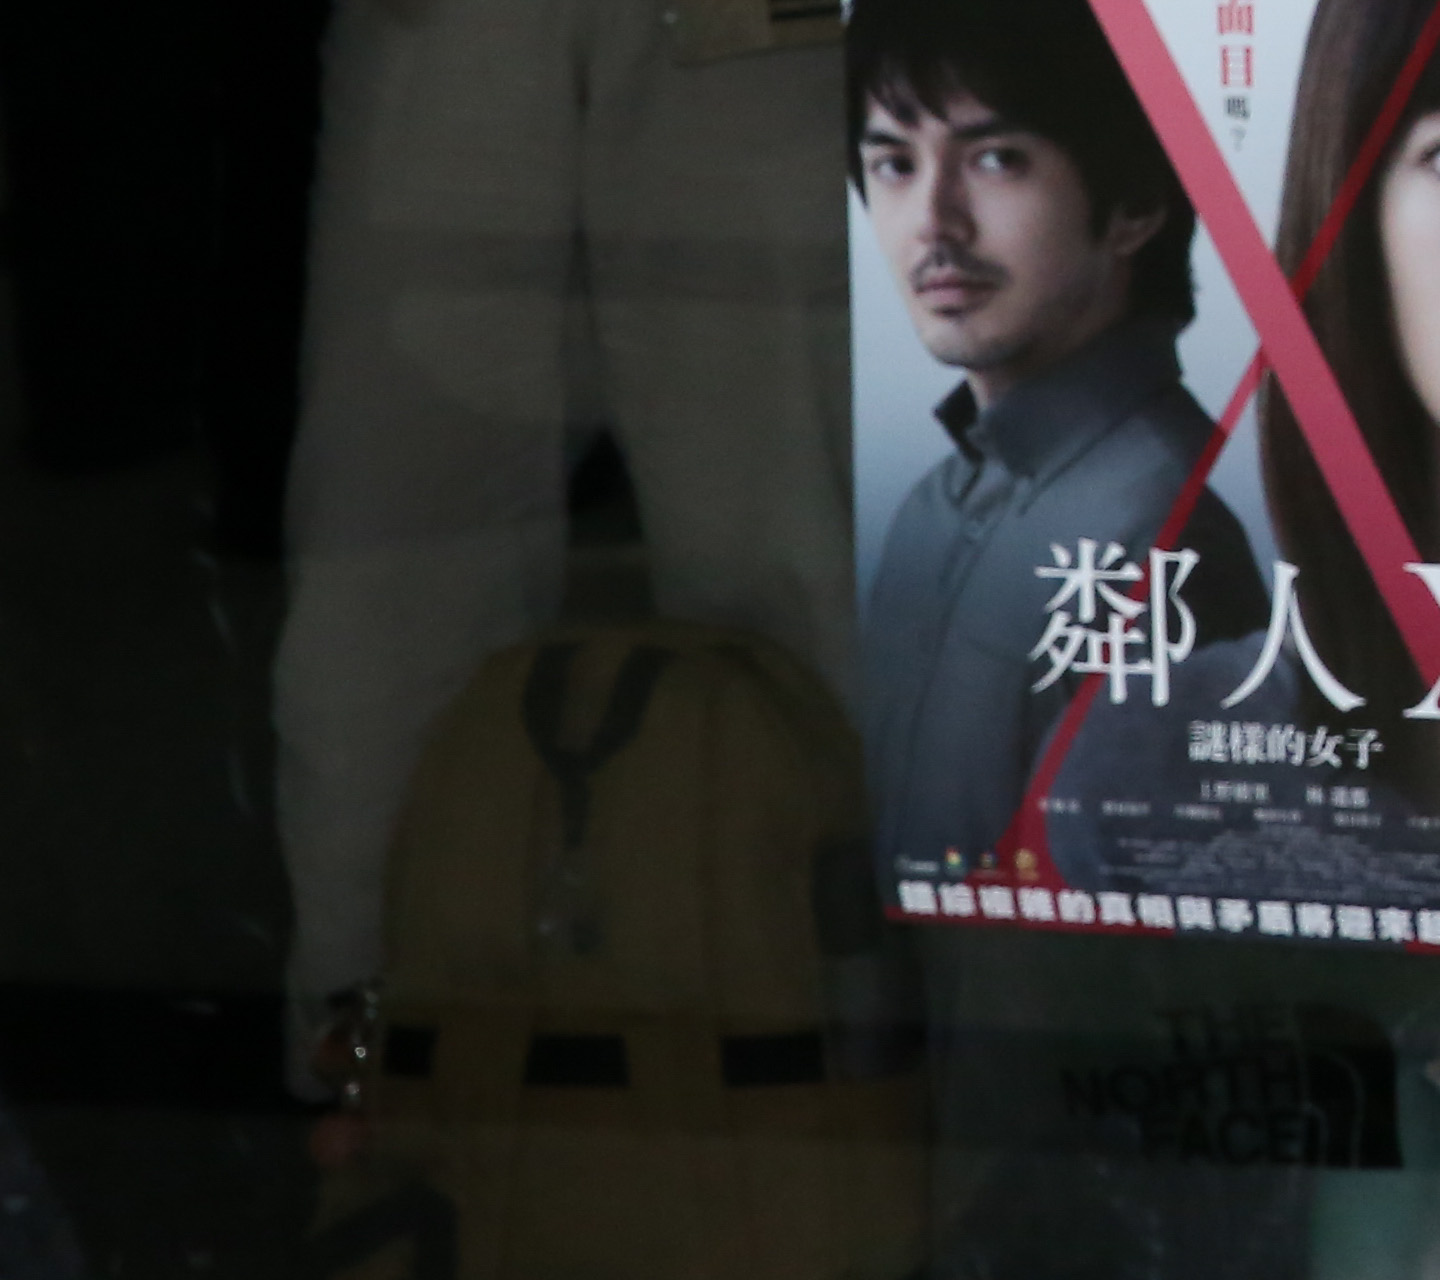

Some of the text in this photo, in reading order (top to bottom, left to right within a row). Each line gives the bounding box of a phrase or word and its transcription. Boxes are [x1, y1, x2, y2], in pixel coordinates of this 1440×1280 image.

[1187, 719, 1385, 770] 謎樣的女子
